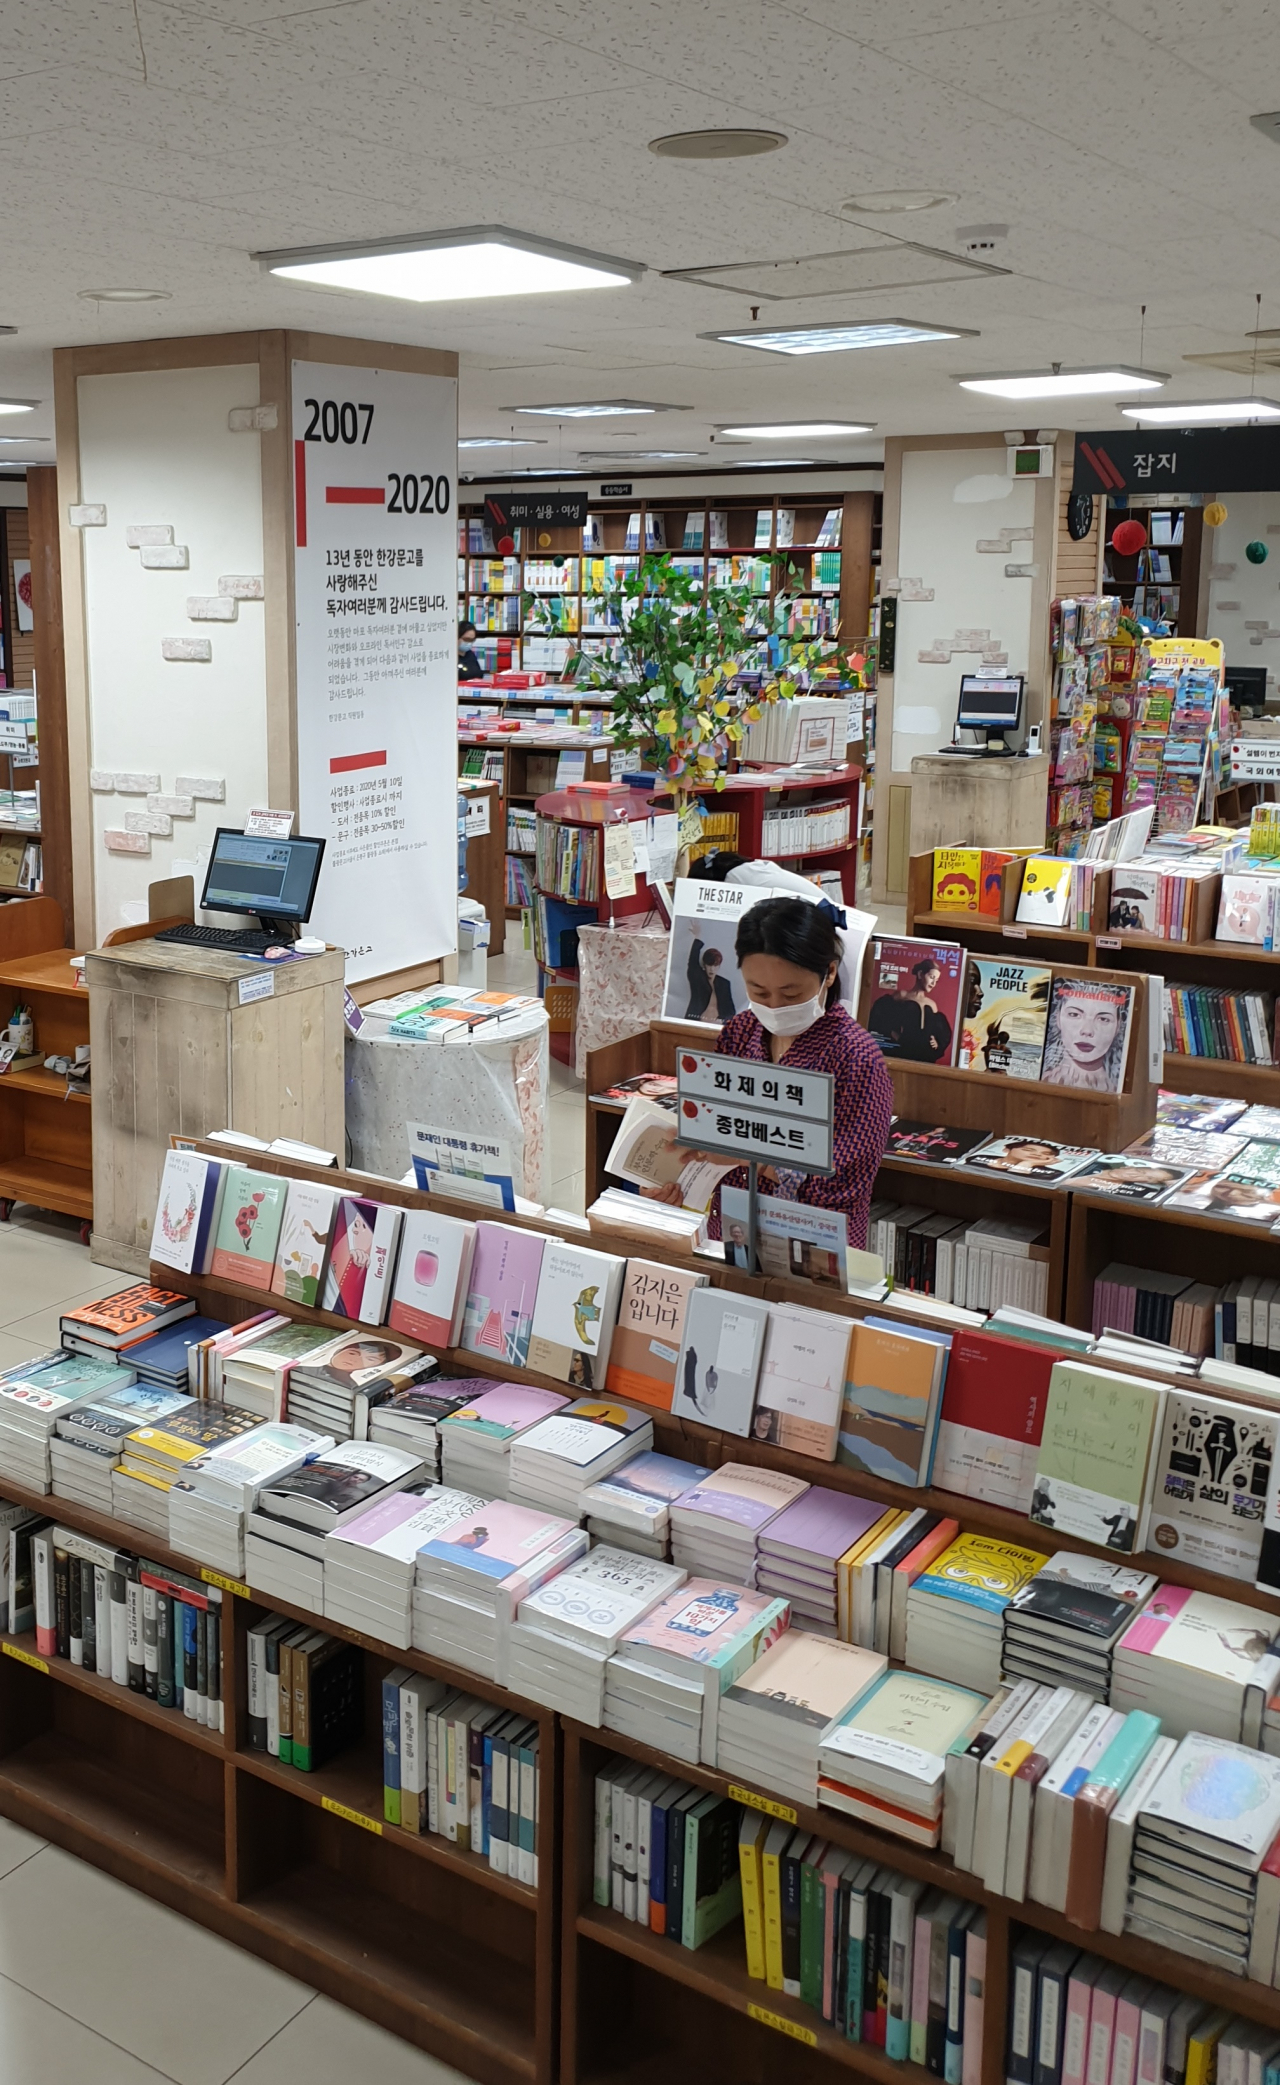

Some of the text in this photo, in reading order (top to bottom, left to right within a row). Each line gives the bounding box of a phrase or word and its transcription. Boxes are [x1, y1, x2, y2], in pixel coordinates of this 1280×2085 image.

[304, 398, 374, 444] 2007
[1132, 452, 1177, 478] 잡지
[387, 473, 450, 514] 2020
[326, 547, 424, 568] 13년 동안 한강문고를
[326, 573, 378, 593] 사랑해주신
[326, 595, 448, 617] 독자여러분께 감사드립니다.
[327, 627, 351, 639] 오랫동안
[360, 640, 382, 651] 오프라인
[407, 638, 424, 648] 감소로
[363, 670, 379, 682] 그동안
[330, 776, 403, 798] 사업종료 2020년 5월 10일
[330, 799, 355, 814] 할인행사
[390, 790, 402, 802] 까지
[337, 816, 349, 827] 도서
[371, 807, 383, 818] 10%
[384, 805, 396, 817] 할인
[337, 831, 349, 842] 문구
[699, 887, 743, 905] THE STAR
[882, 948, 935, 959] AUDITORIUM
[933, 948, 960, 965] 객석
[996, 967, 1024, 980] JAZZ
[989, 978, 1028, 993] PEOPLE
[417, 1131, 441, 1145] 문재인
[443, 1137, 467, 1150] 대통령
[716, 1114, 804, 1150] 종합베스트
[891, 1132, 959, 1148] MAPS
[1100, 1154, 1151, 1167] GQ
[631, 1273, 683, 1305] 김지은
[82, 1301, 148, 1324] NESS
[629, 1299, 679, 1330] 입니다
[1199, 1485, 1229, 1505] 삶의
[1233, 1493, 1266, 1511] 무기가
[1232, 1505, 1266, 1523] 되는가
[968, 1538, 994, 1550] 1cm
[597, 1570, 633, 1585] 365
[685, 1611, 718, 1624] 10가지
